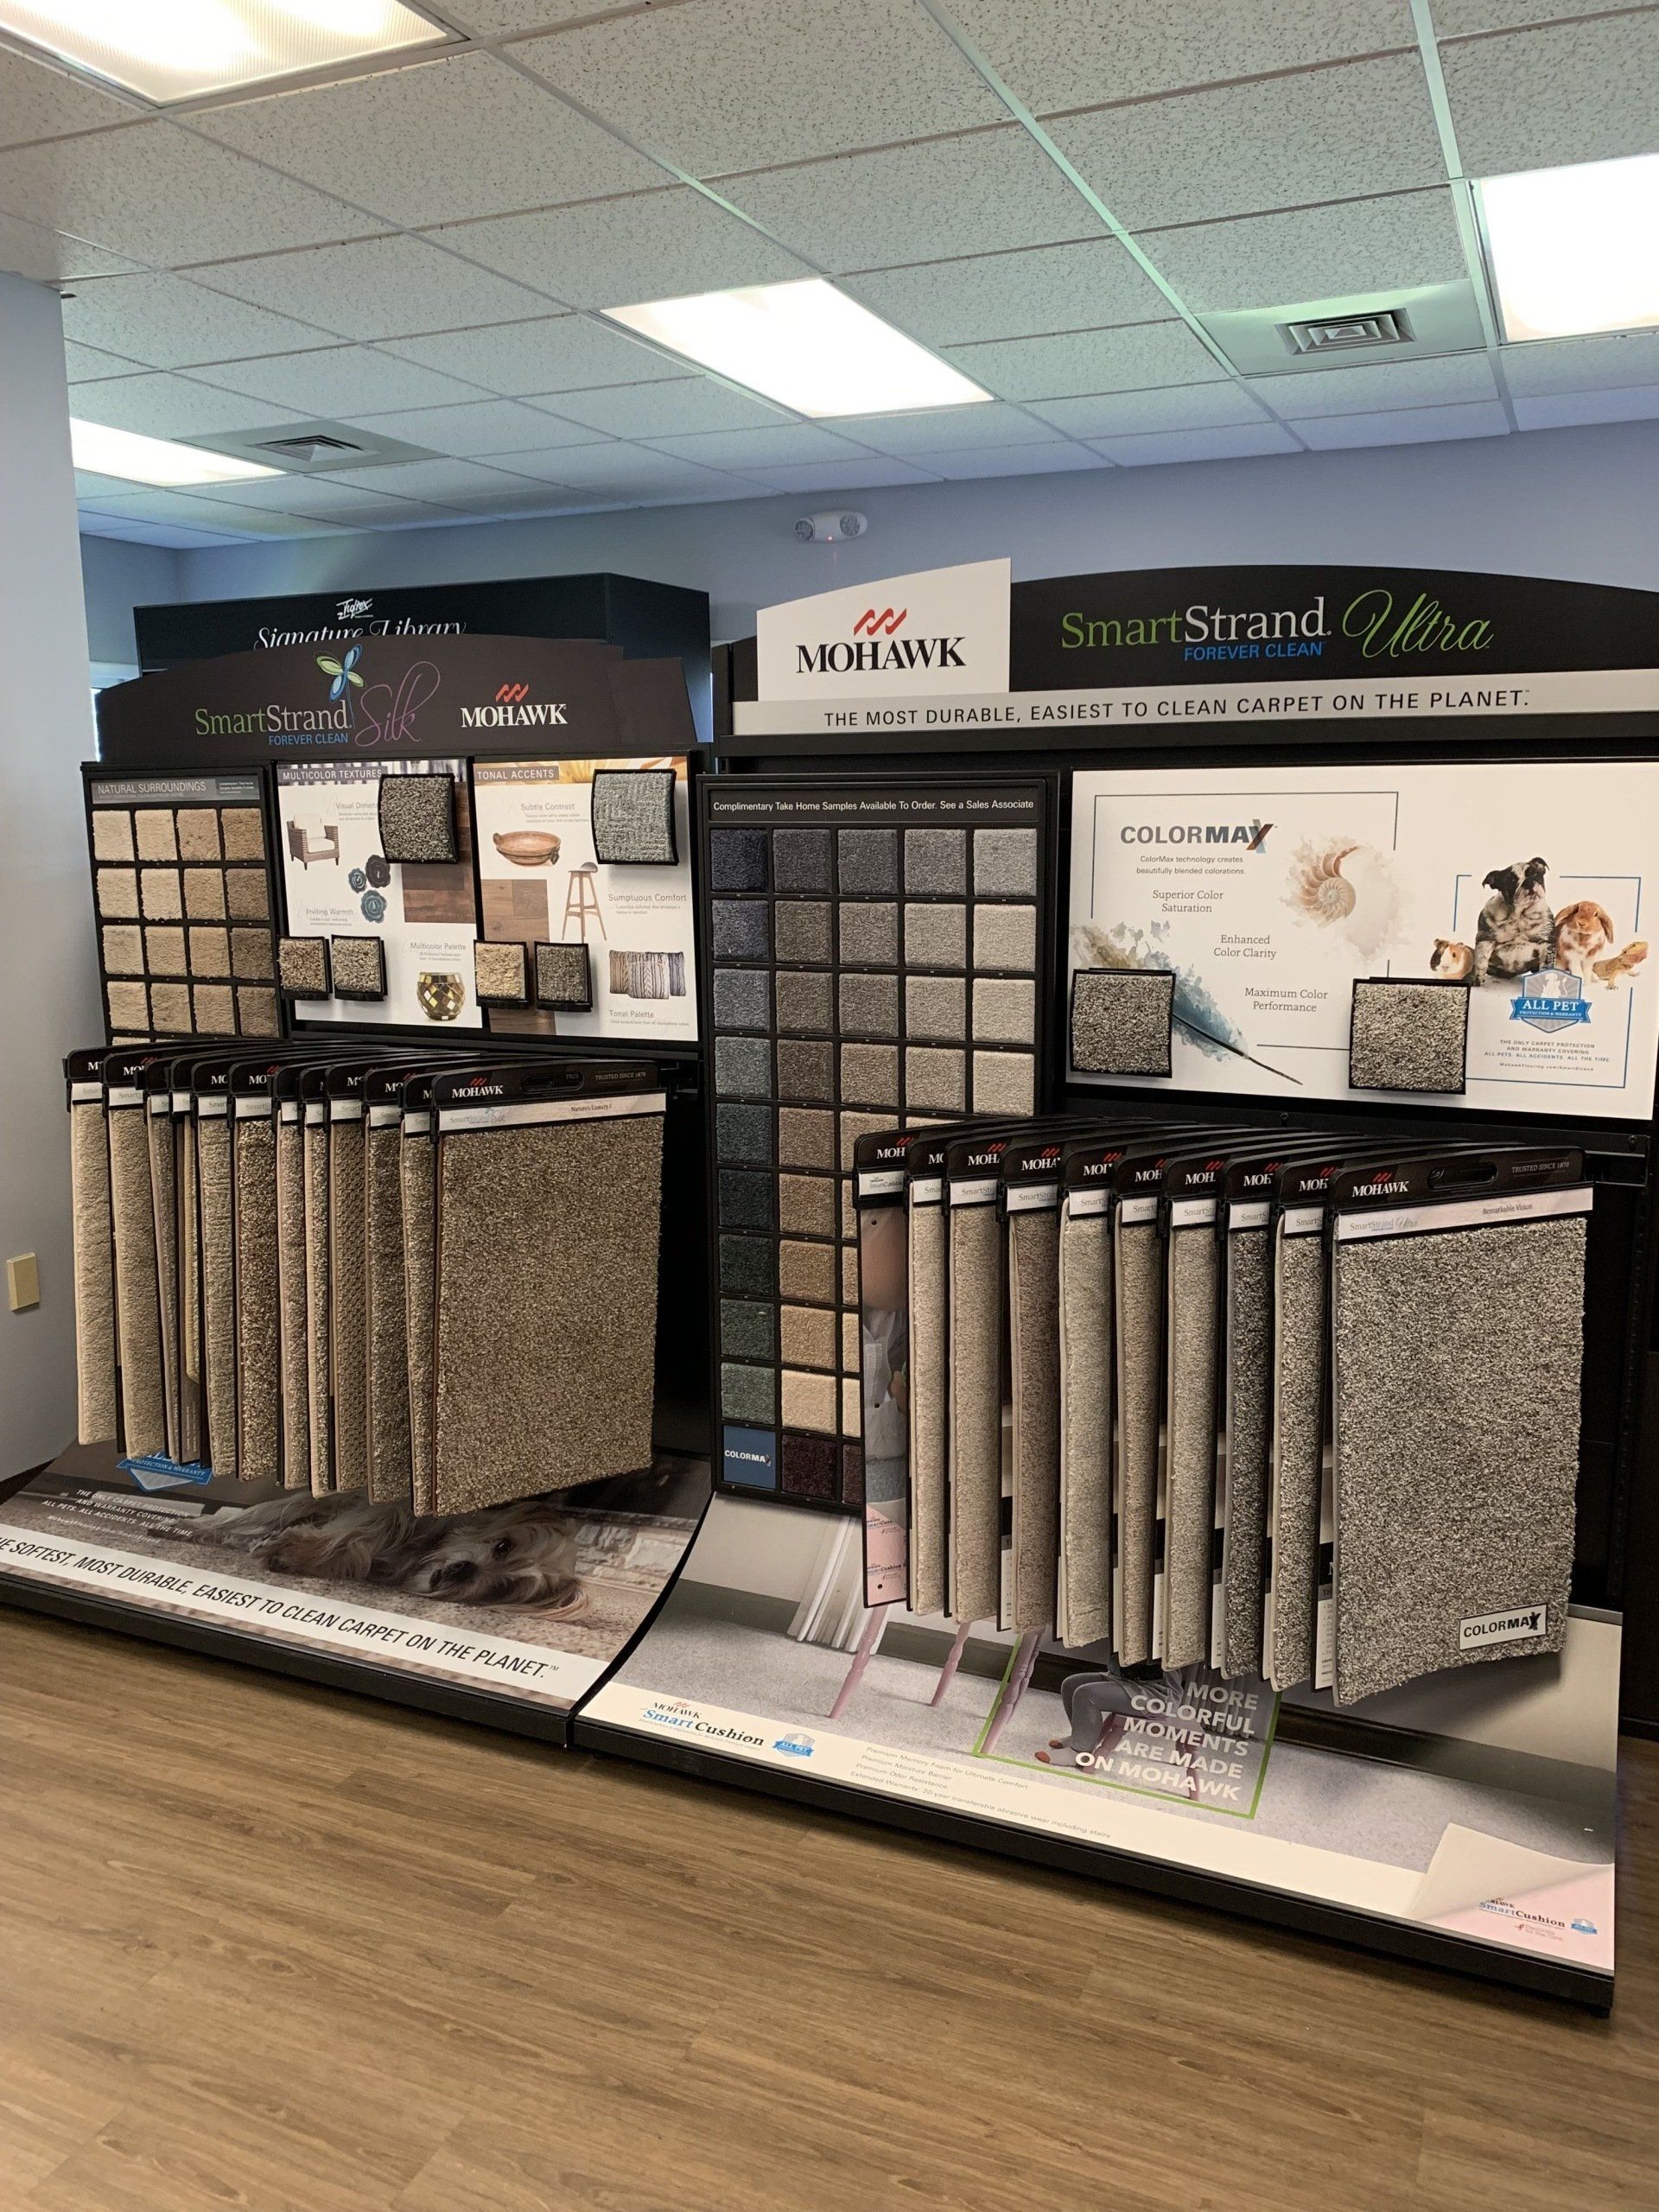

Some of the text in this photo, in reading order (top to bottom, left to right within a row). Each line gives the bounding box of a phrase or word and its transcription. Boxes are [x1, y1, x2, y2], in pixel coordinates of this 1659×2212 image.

[1061, 588, 1494, 658] SmartStrand Ultra
[796, 636, 967, 674] MOHAWK
[1185, 642, 1322, 662] FOREVER CLEAN
[354, 661, 440, 747] Silk
[824, 712, 858, 727] THE
[867, 710, 918, 725] MOST
[926, 707, 1020, 724] DURABLE,
[1031, 703, 1113, 720] EASIEST
[1122, 702, 1147, 717] TO
[1157, 699, 1227, 716] CLEAN
[1237, 696, 1323, 713] CARPET
[1332, 695, 1364, 710] ON
[1375, 693, 1420, 709] THE
[194, 700, 349, 734] SmartStrand
[461, 704, 568, 728] MOHAWK
[269, 734, 348, 746] FOREVER CLEAN
[283, 769, 382, 779] MULTICOLOR TEXTURES
[477, 769, 554, 779] TONAL ACCENTS
[98, 783, 137, 795] NATURAL
[138, 781, 207, 793] SURROUNDINGS
[714, 802, 773, 812] Complimentary
[775, 802, 793, 810] Take
[796, 801, 820, 810] Home
[823, 801, 857, 811] Samples
[860, 800, 896, 810] Available
[899, 801, 909, 810] To
[912, 800, 938, 810] Order.
[940, 800, 957, 810] See
[966, 800, 989, 809] Sales
[992, 799, 1034, 809] Associate
[1120, 819, 1274, 854] COLORMAX
[1136, 867, 1172, 875] beautifully
[608, 893, 652, 902] Sumptuous
[1153, 890, 1224, 901] Superior Color
[1161, 903, 1212, 912] Saturation
[1221, 934, 1270, 944] Enhanced
[1213, 947, 1276, 960] Color Clarity
[1244, 988, 1328, 999] Maximum Color
[1253, 1001, 1317, 1012] Performance
[1522, 1001, 1579, 1011] ALL PET
[452, 1085, 504, 1098] MOHAWK
[876, 1147, 906, 1160] MOH
[968, 1154, 1000, 1166] MOH
[1135, 1169, 1162, 1182] MOH
[1512, 1164, 1537, 1173] TRUSTED
[1185, 1172, 1216, 1185] MOH
[1352, 1181, 1409, 1197] MOHAWK
[173, 1465, 206, 1476] WARRANTY
[76, 1489, 91, 1497] THE
[93, 1501, 137, 1516] WARRANTY
[137, 1510, 176, 1523] COVERING
[139, 1520, 154, 1529] ALL
[156, 1523, 172, 1532] THE
[0, 1536, 475, 1660] HE SOFTEST, MOST DURABLE, EASIEST TO CLEAN CARPET ON THE
[1464, 1611, 1541, 1637] COLORMAX
[1187, 1681, 1259, 1711] MORE
[652, 1702, 702, 1719] MOHAWK
[1131, 1694, 1255, 1735] COLORFUL
[1123, 1717, 1249, 1757] MOMENTS
[1114, 1739, 1243, 1779] ARE MADE
[861, 1754, 952, 1780] Premium Moisture Barrier
[866, 1746, 901, 1758] Premium
[899, 1754, 928, 1767] Memory
[931, 1762, 951, 1771] Foam
[964, 1770, 996, 1782] Ultimate
[997, 1777, 1028, 1790] Comfort
[855, 1763, 887, 1775] Premium
[909, 1775, 948, 1789] Resistance
[1075, 1752, 1243, 1802] ON MOHAWK
[850, 1770, 1110, 1839] Extended transferable abrasive wear including stairs
[1479, 1902, 1566, 1928] SmartCushion
